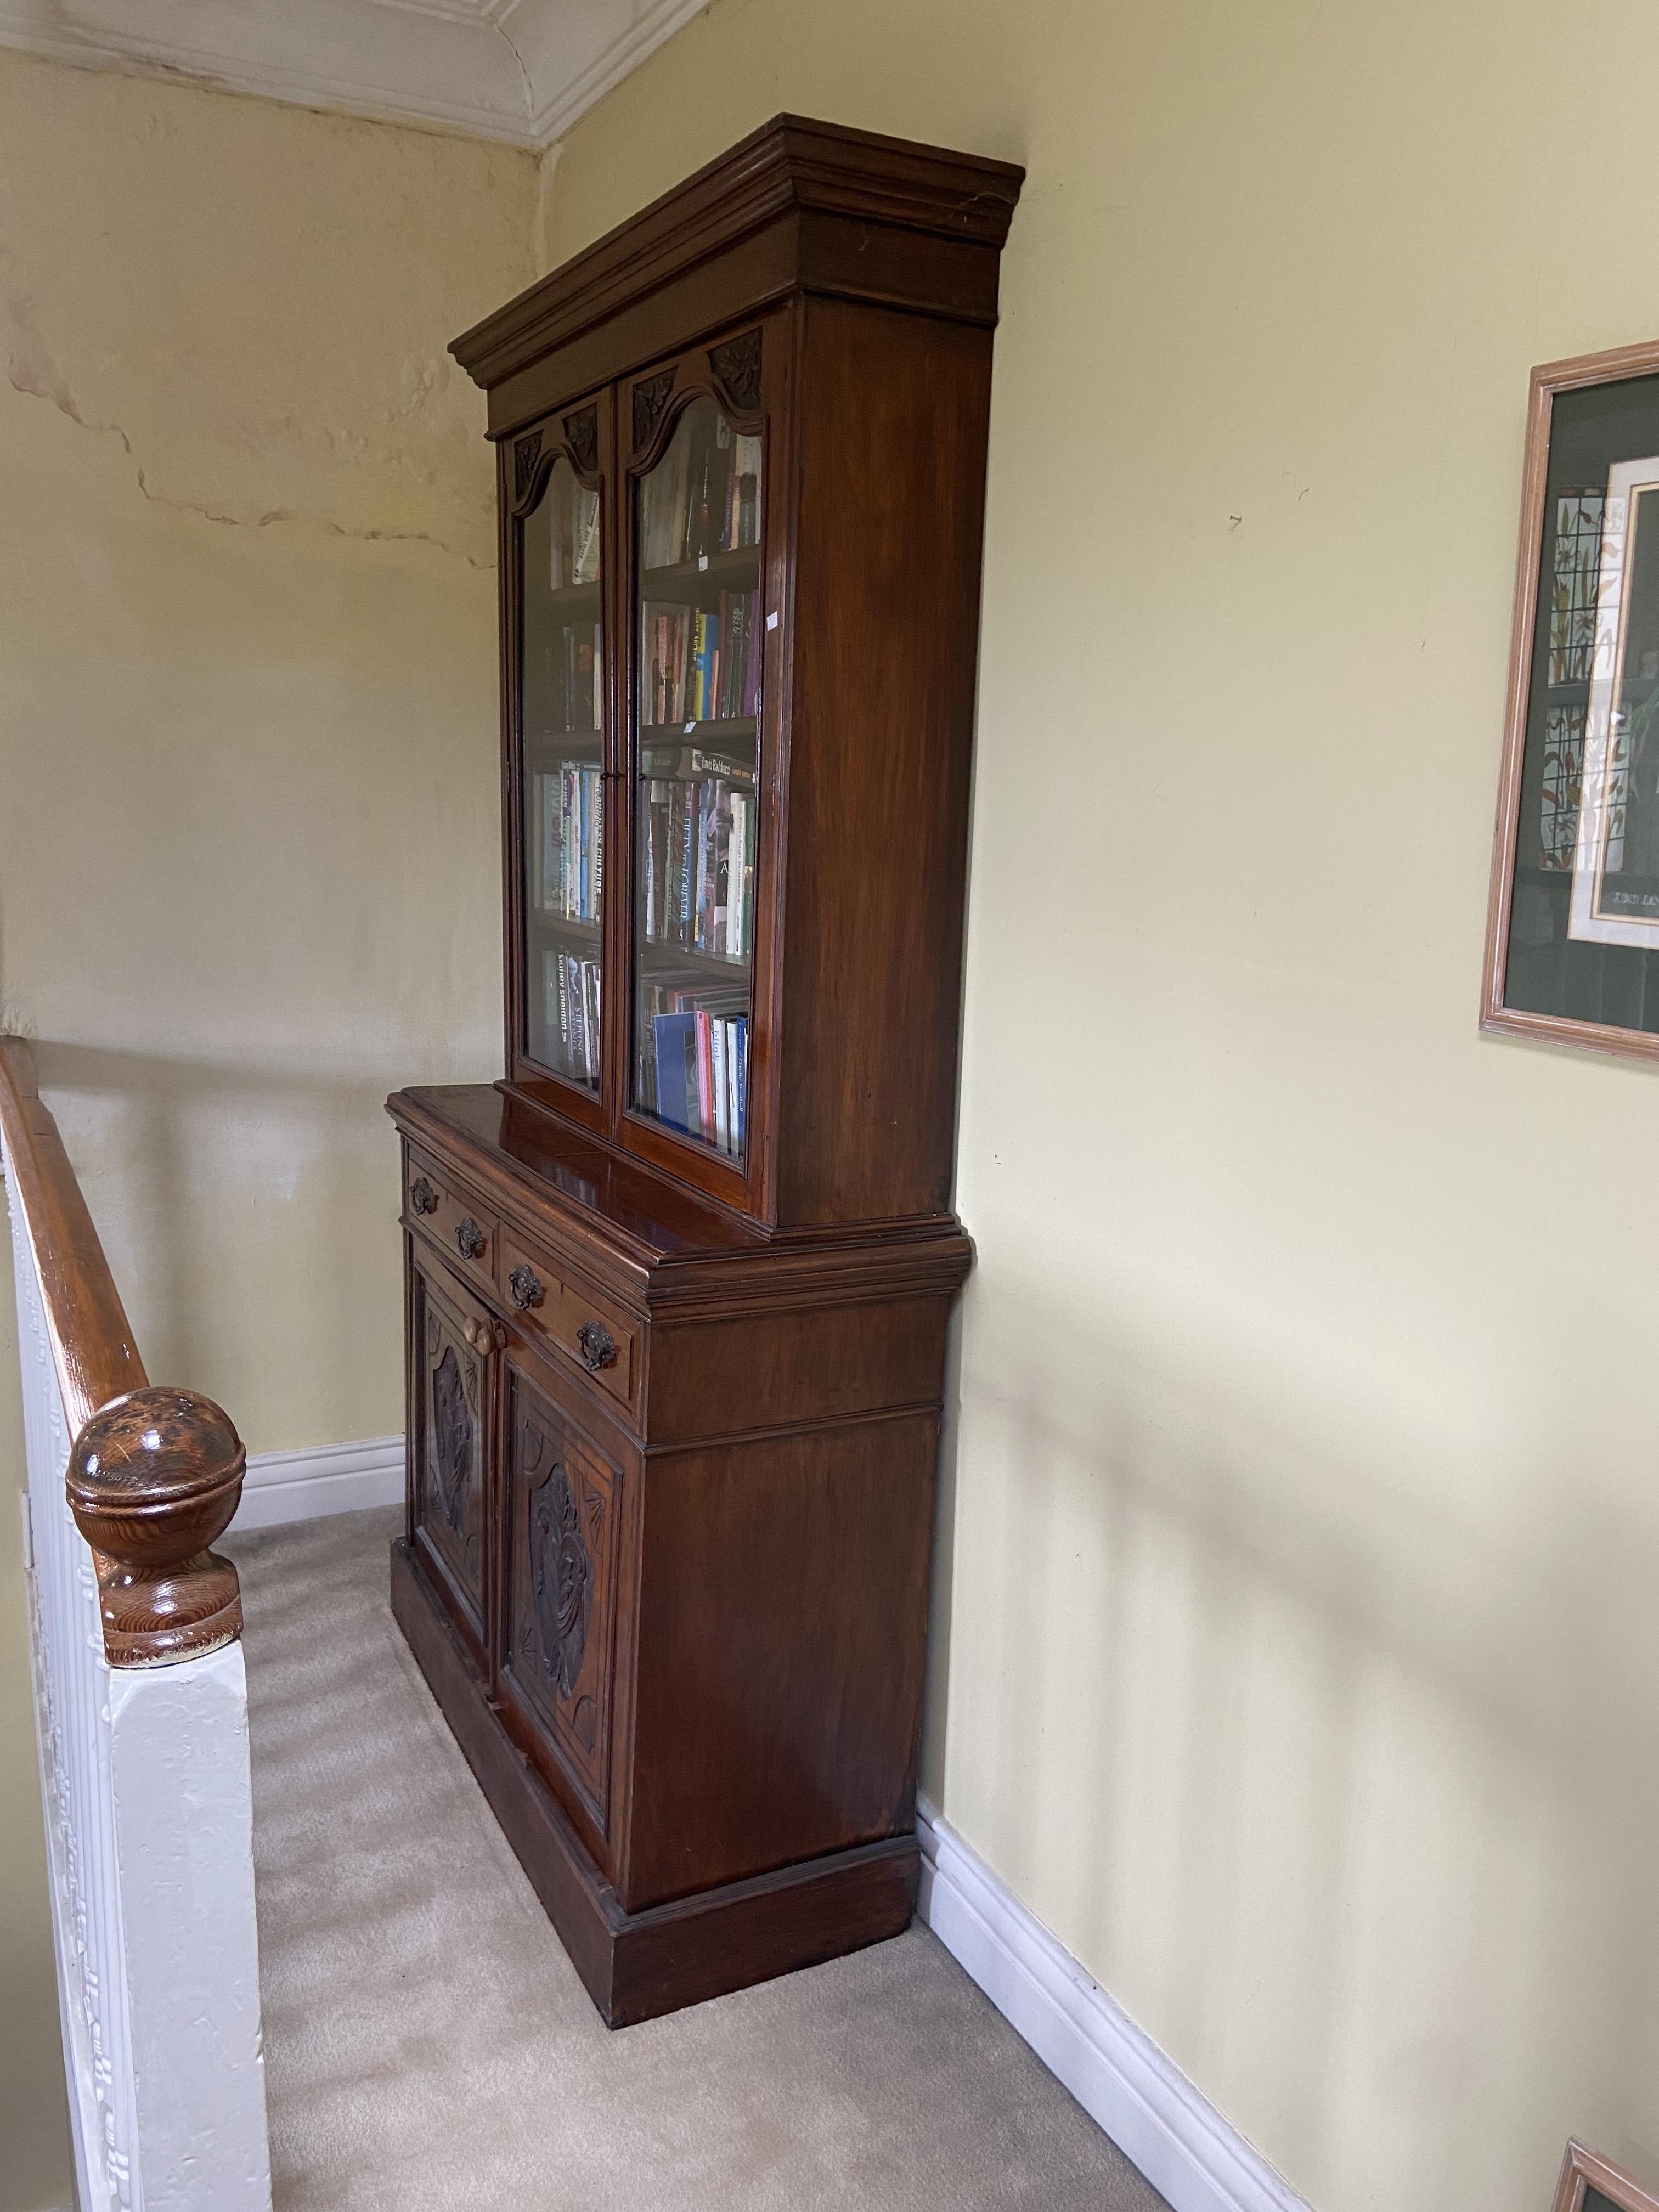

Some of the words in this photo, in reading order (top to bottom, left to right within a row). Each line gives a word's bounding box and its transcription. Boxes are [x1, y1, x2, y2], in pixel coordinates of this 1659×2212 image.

[702, 756, 712, 770] David
[713, 759, 730, 775] Baldacci
[680, 868, 689, 918] FOREVER
[575, 1007, 583, 1056] STEPPING
